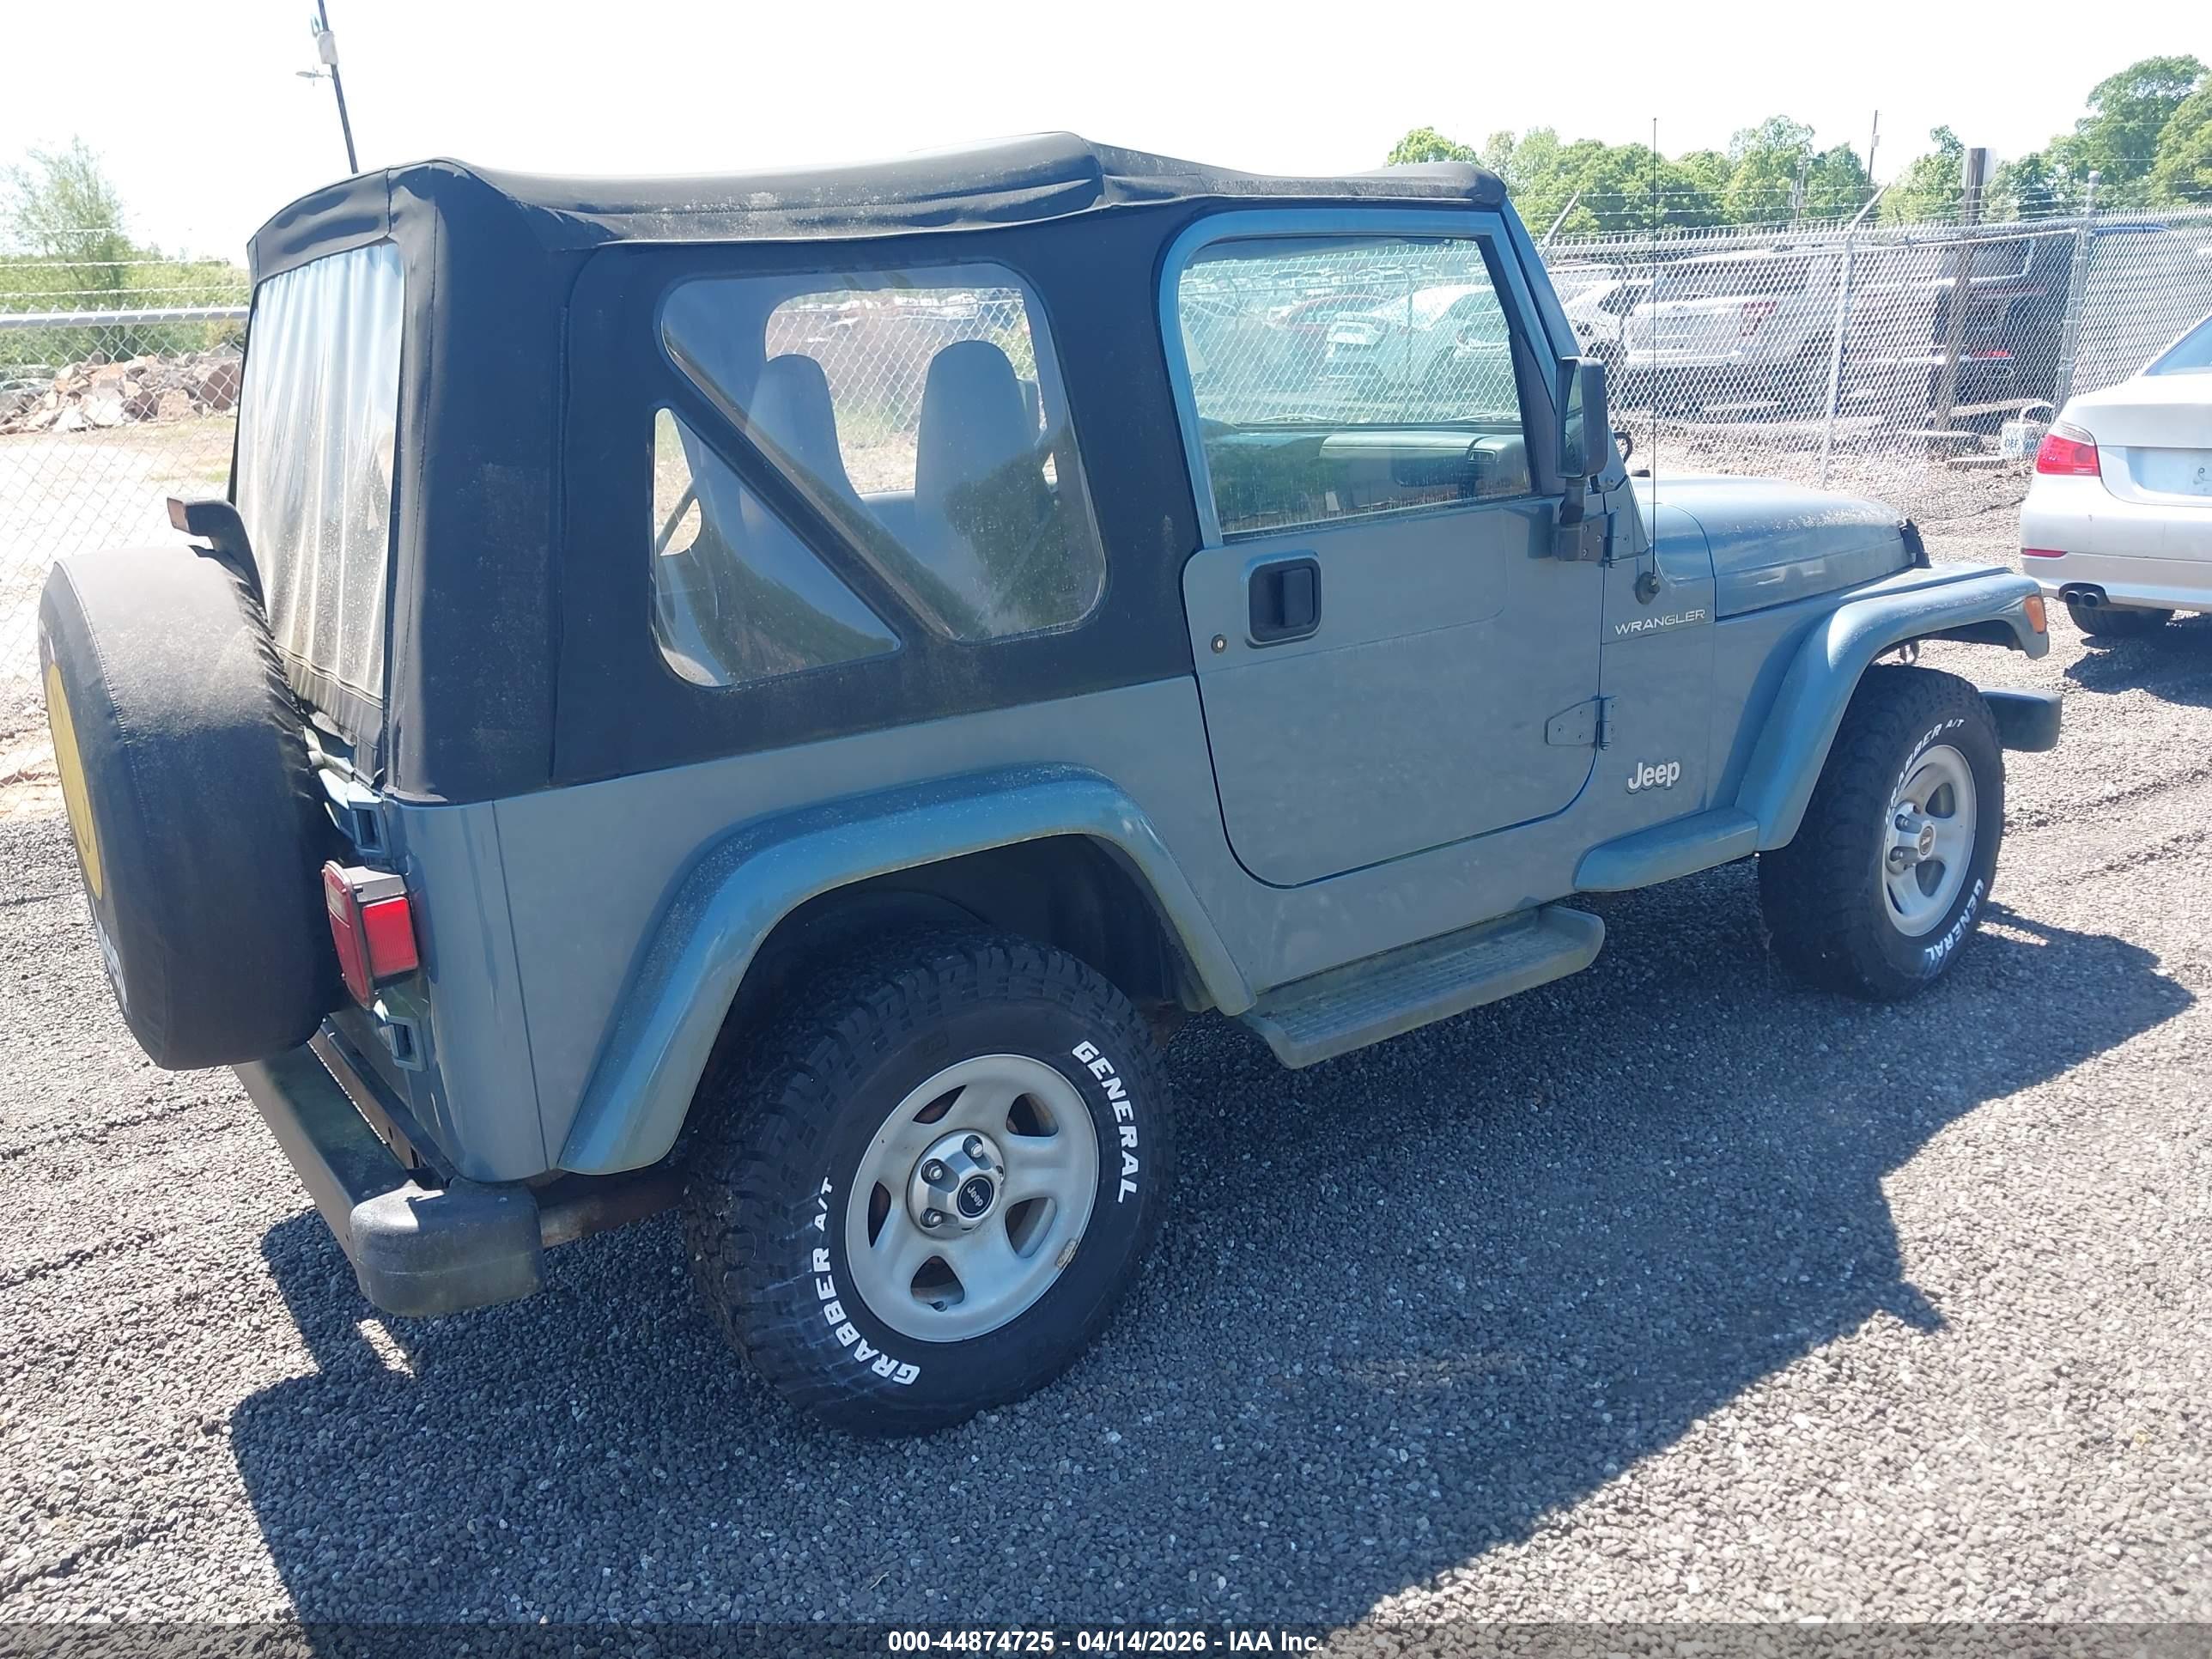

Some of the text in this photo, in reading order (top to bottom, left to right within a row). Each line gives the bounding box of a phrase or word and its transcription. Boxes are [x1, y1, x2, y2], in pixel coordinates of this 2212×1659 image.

[1614, 609, 1705, 635] WRANGLER
[1946, 719, 1965, 728] A/T
[1627, 761, 1680, 790] Jeep
[1924, 878, 1985, 961] GENERAL
[1072, 1040, 1139, 1203] GENERAL
[967, 1186, 984, 1206] Jeep
[812, 1176, 921, 1385] GRABBER A/T
